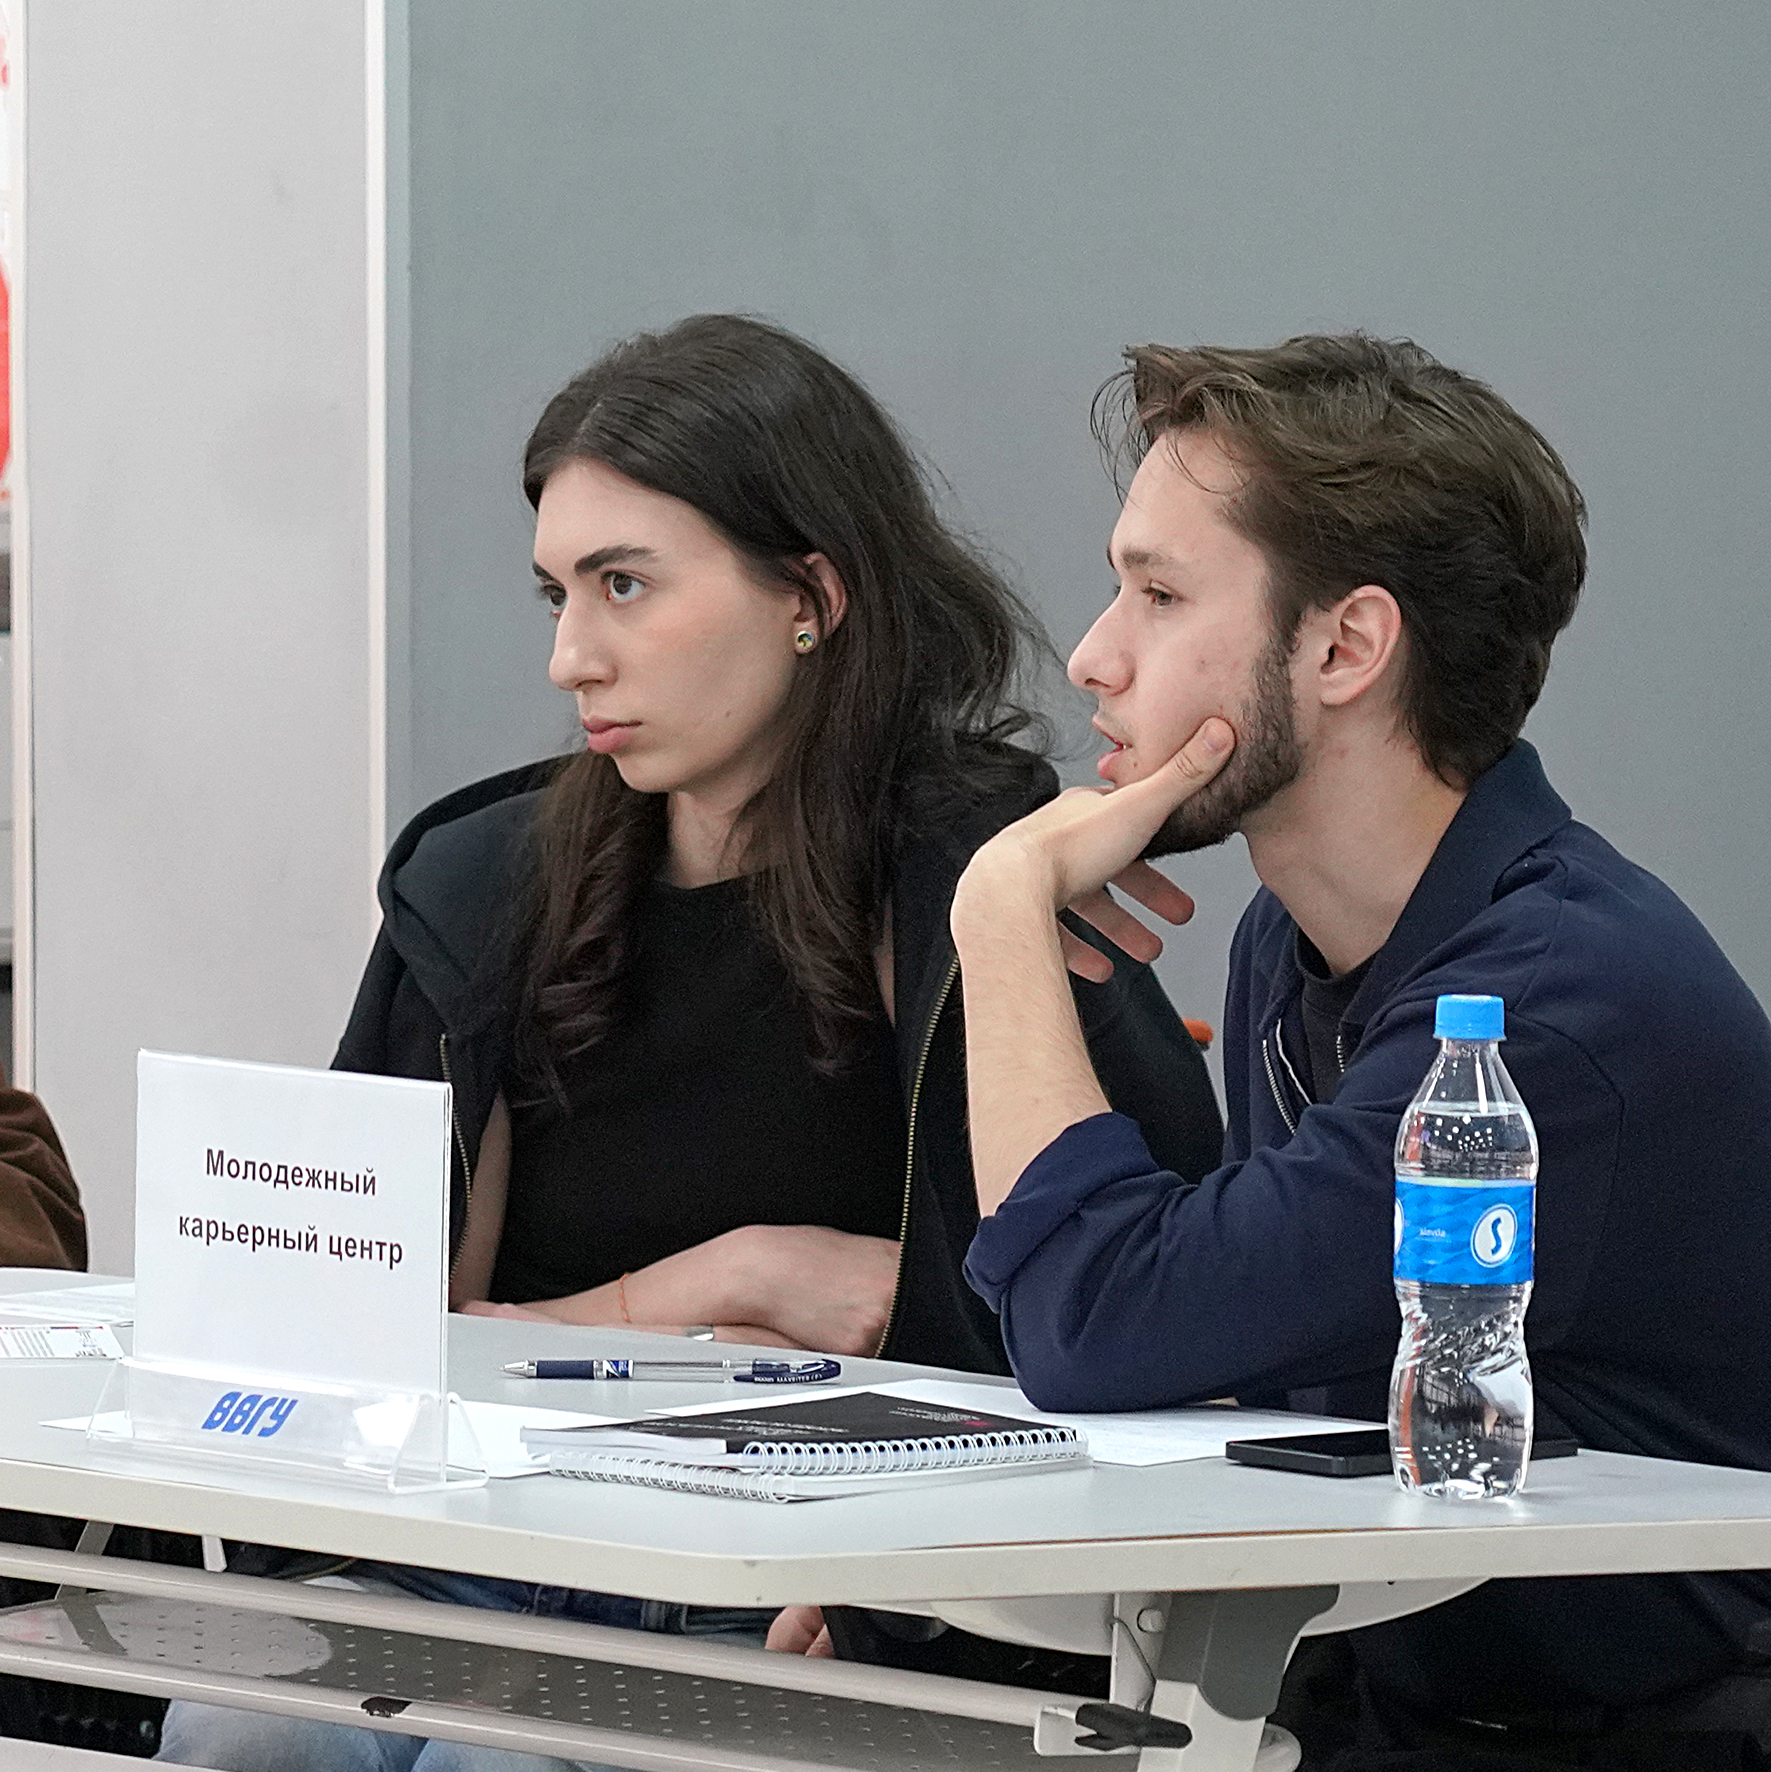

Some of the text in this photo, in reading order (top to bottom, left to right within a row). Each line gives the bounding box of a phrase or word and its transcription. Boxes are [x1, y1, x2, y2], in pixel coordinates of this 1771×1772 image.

[205, 1147, 376, 1196] Молодежный
[178, 1213, 404, 1271] карьерный центр
[200, 1390, 299, 1438] ВВГУ
